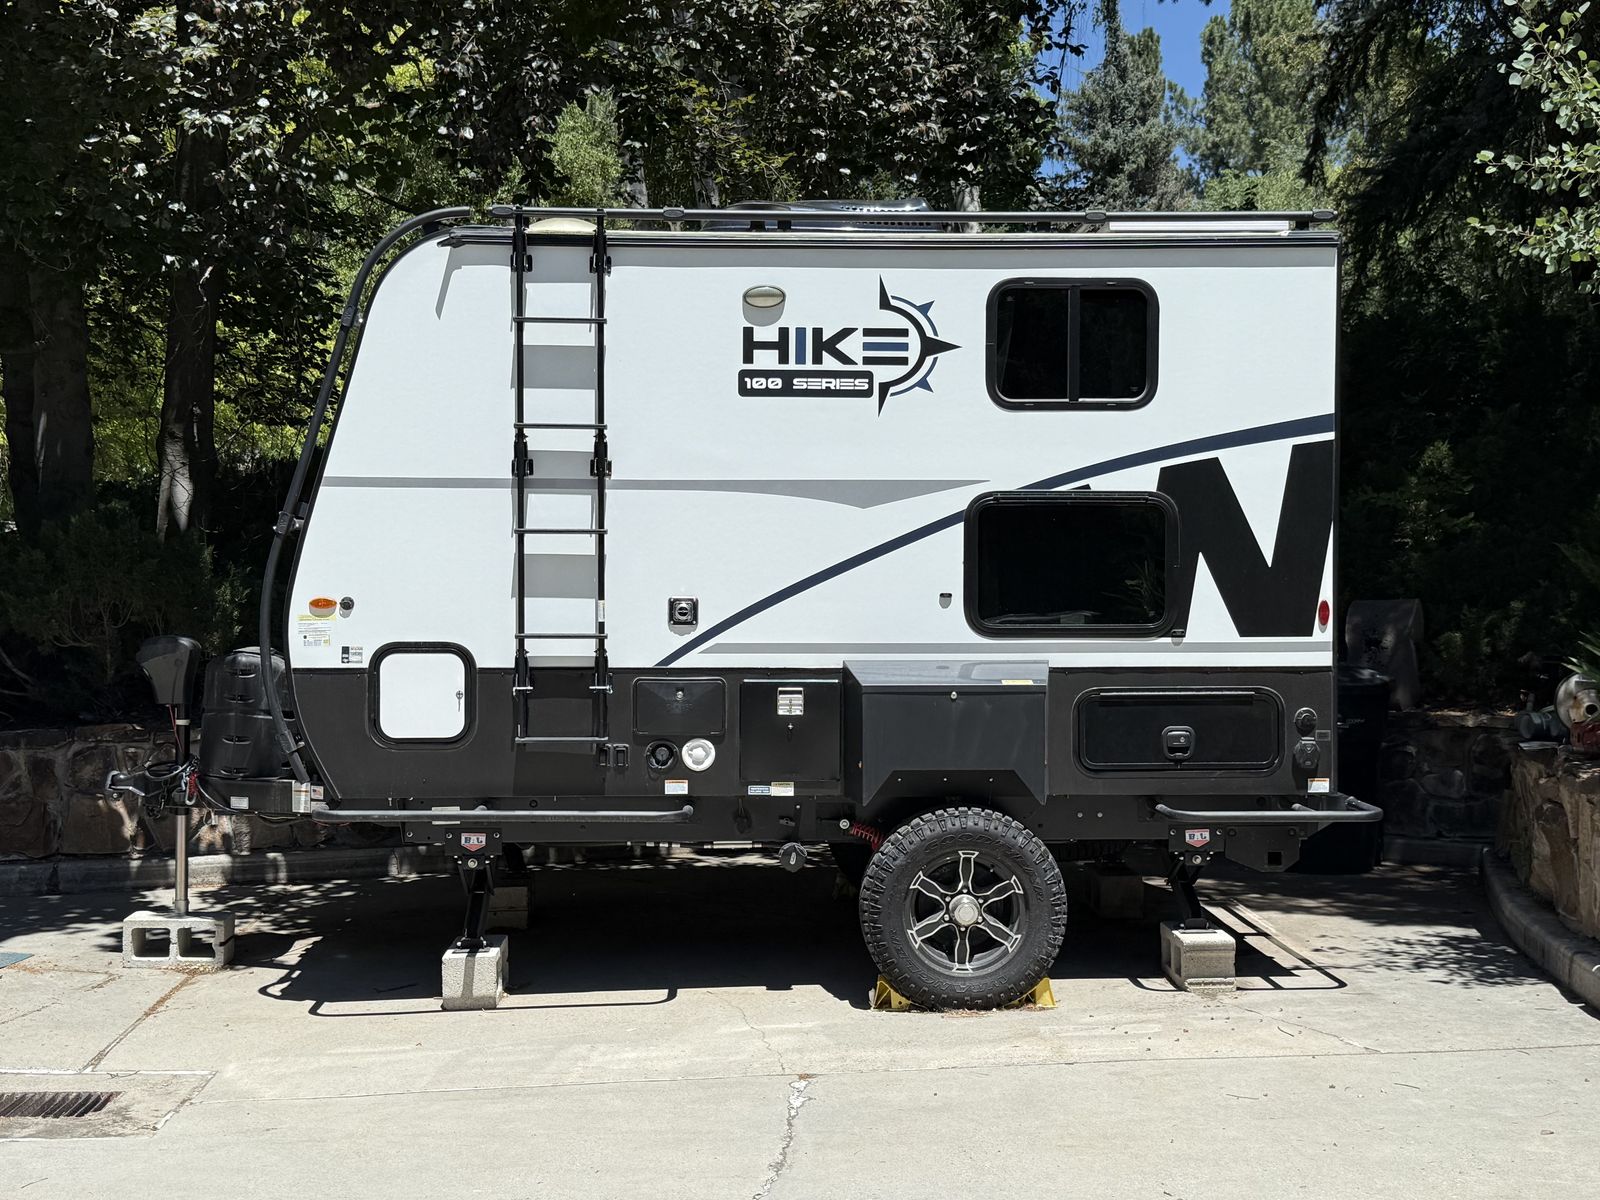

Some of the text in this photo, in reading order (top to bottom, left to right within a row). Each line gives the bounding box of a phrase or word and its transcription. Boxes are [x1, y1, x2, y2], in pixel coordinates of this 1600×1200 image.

[742, 326, 910, 367] HIKE
[744, 377, 870, 390] 100 SERIES
